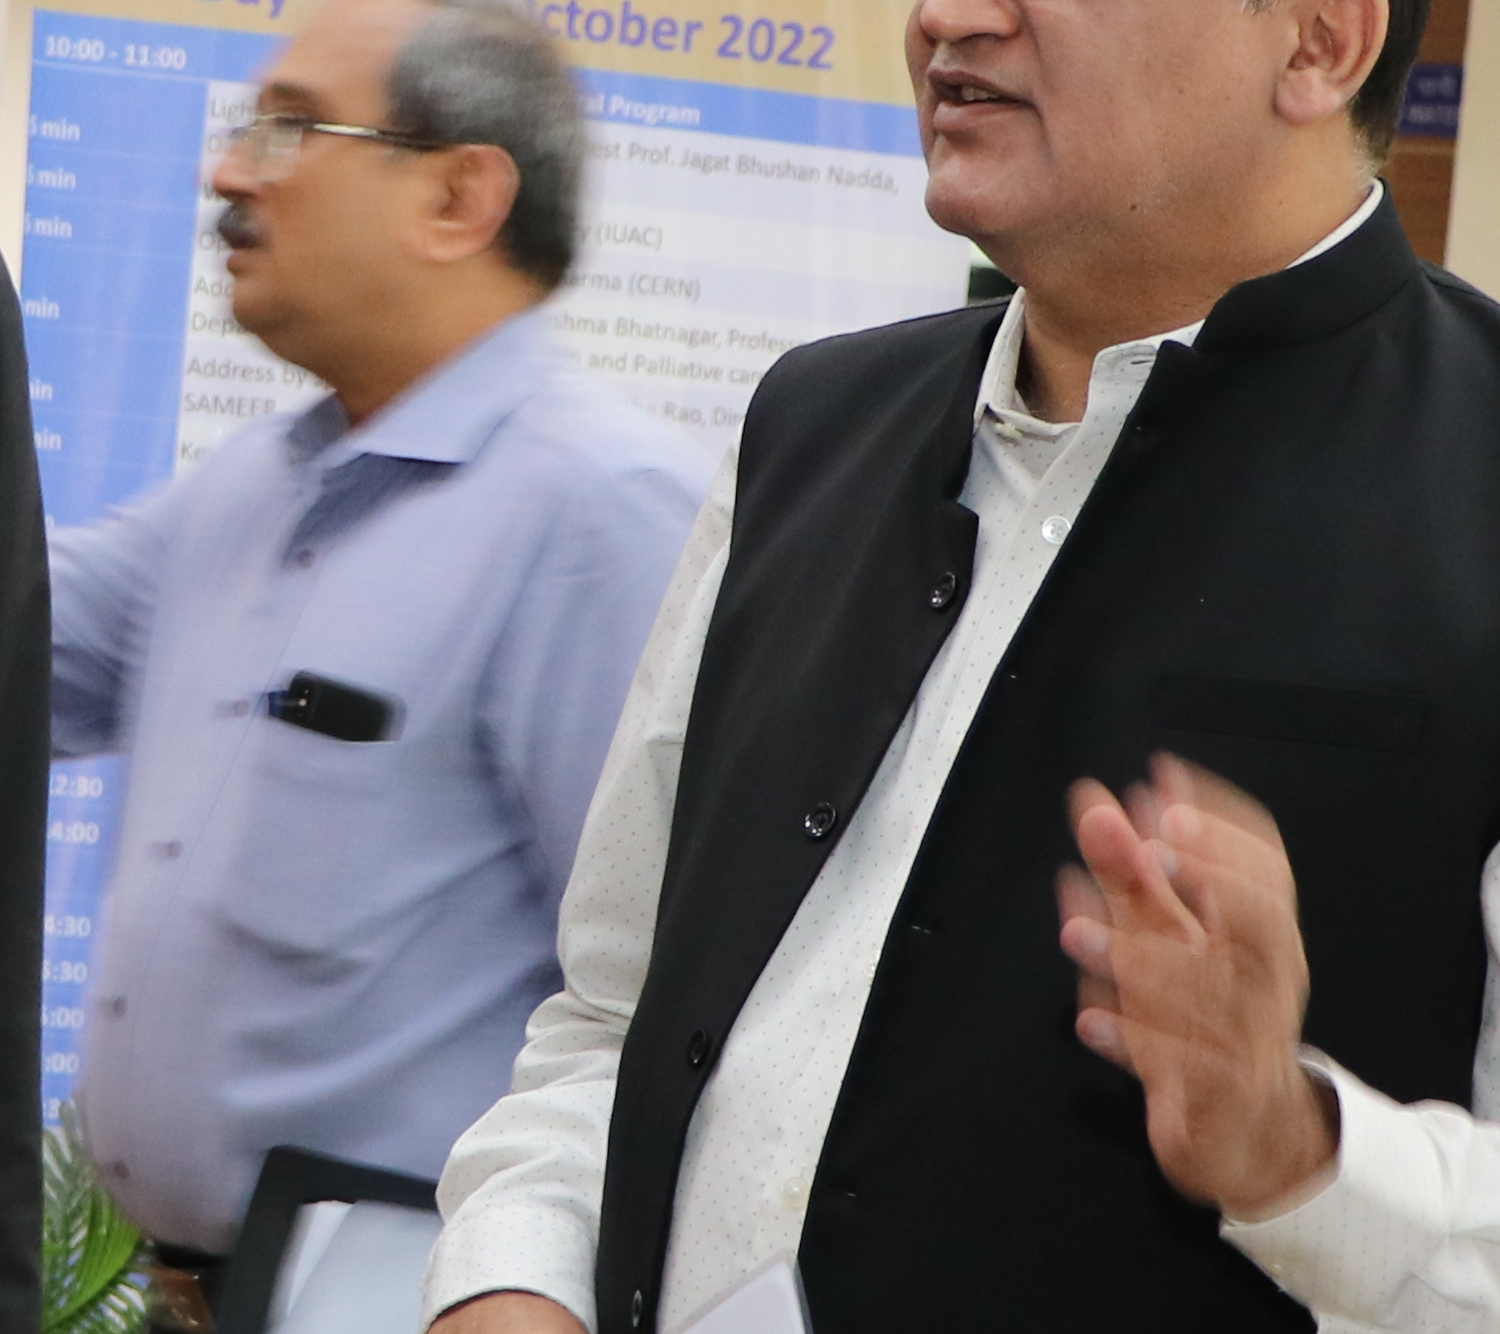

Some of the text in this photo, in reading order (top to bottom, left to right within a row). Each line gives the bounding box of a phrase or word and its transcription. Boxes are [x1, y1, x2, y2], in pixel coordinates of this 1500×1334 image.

[45, 35, 106, 61] 10:00
[124, 42, 188, 70] 11:00
[716, 14, 837, 71] 2022
[608, 94, 701, 126] Program
[41, 117, 82, 142] min
[37, 166, 77, 190] min
[628, 141, 675, 166] Prof.
[682, 149, 731, 176] Jagat
[737, 154, 821, 182] Bhushan
[827, 165, 901, 196] Nadda,
[34, 215, 74, 239] min
[598, 222, 664, 251] (IUAC)
[628, 271, 701, 300] (CERN)
[25, 298, 61, 321] min
[615, 317, 722, 349] Bhatnagar,
[588, 353, 627, 372] and
[634, 354, 723, 382] Palliative
[185, 357, 276, 384] Address
[281, 363, 307, 389] by
[663, 401, 707, 426] Rao,
[48, 820, 101, 845] 4:00
